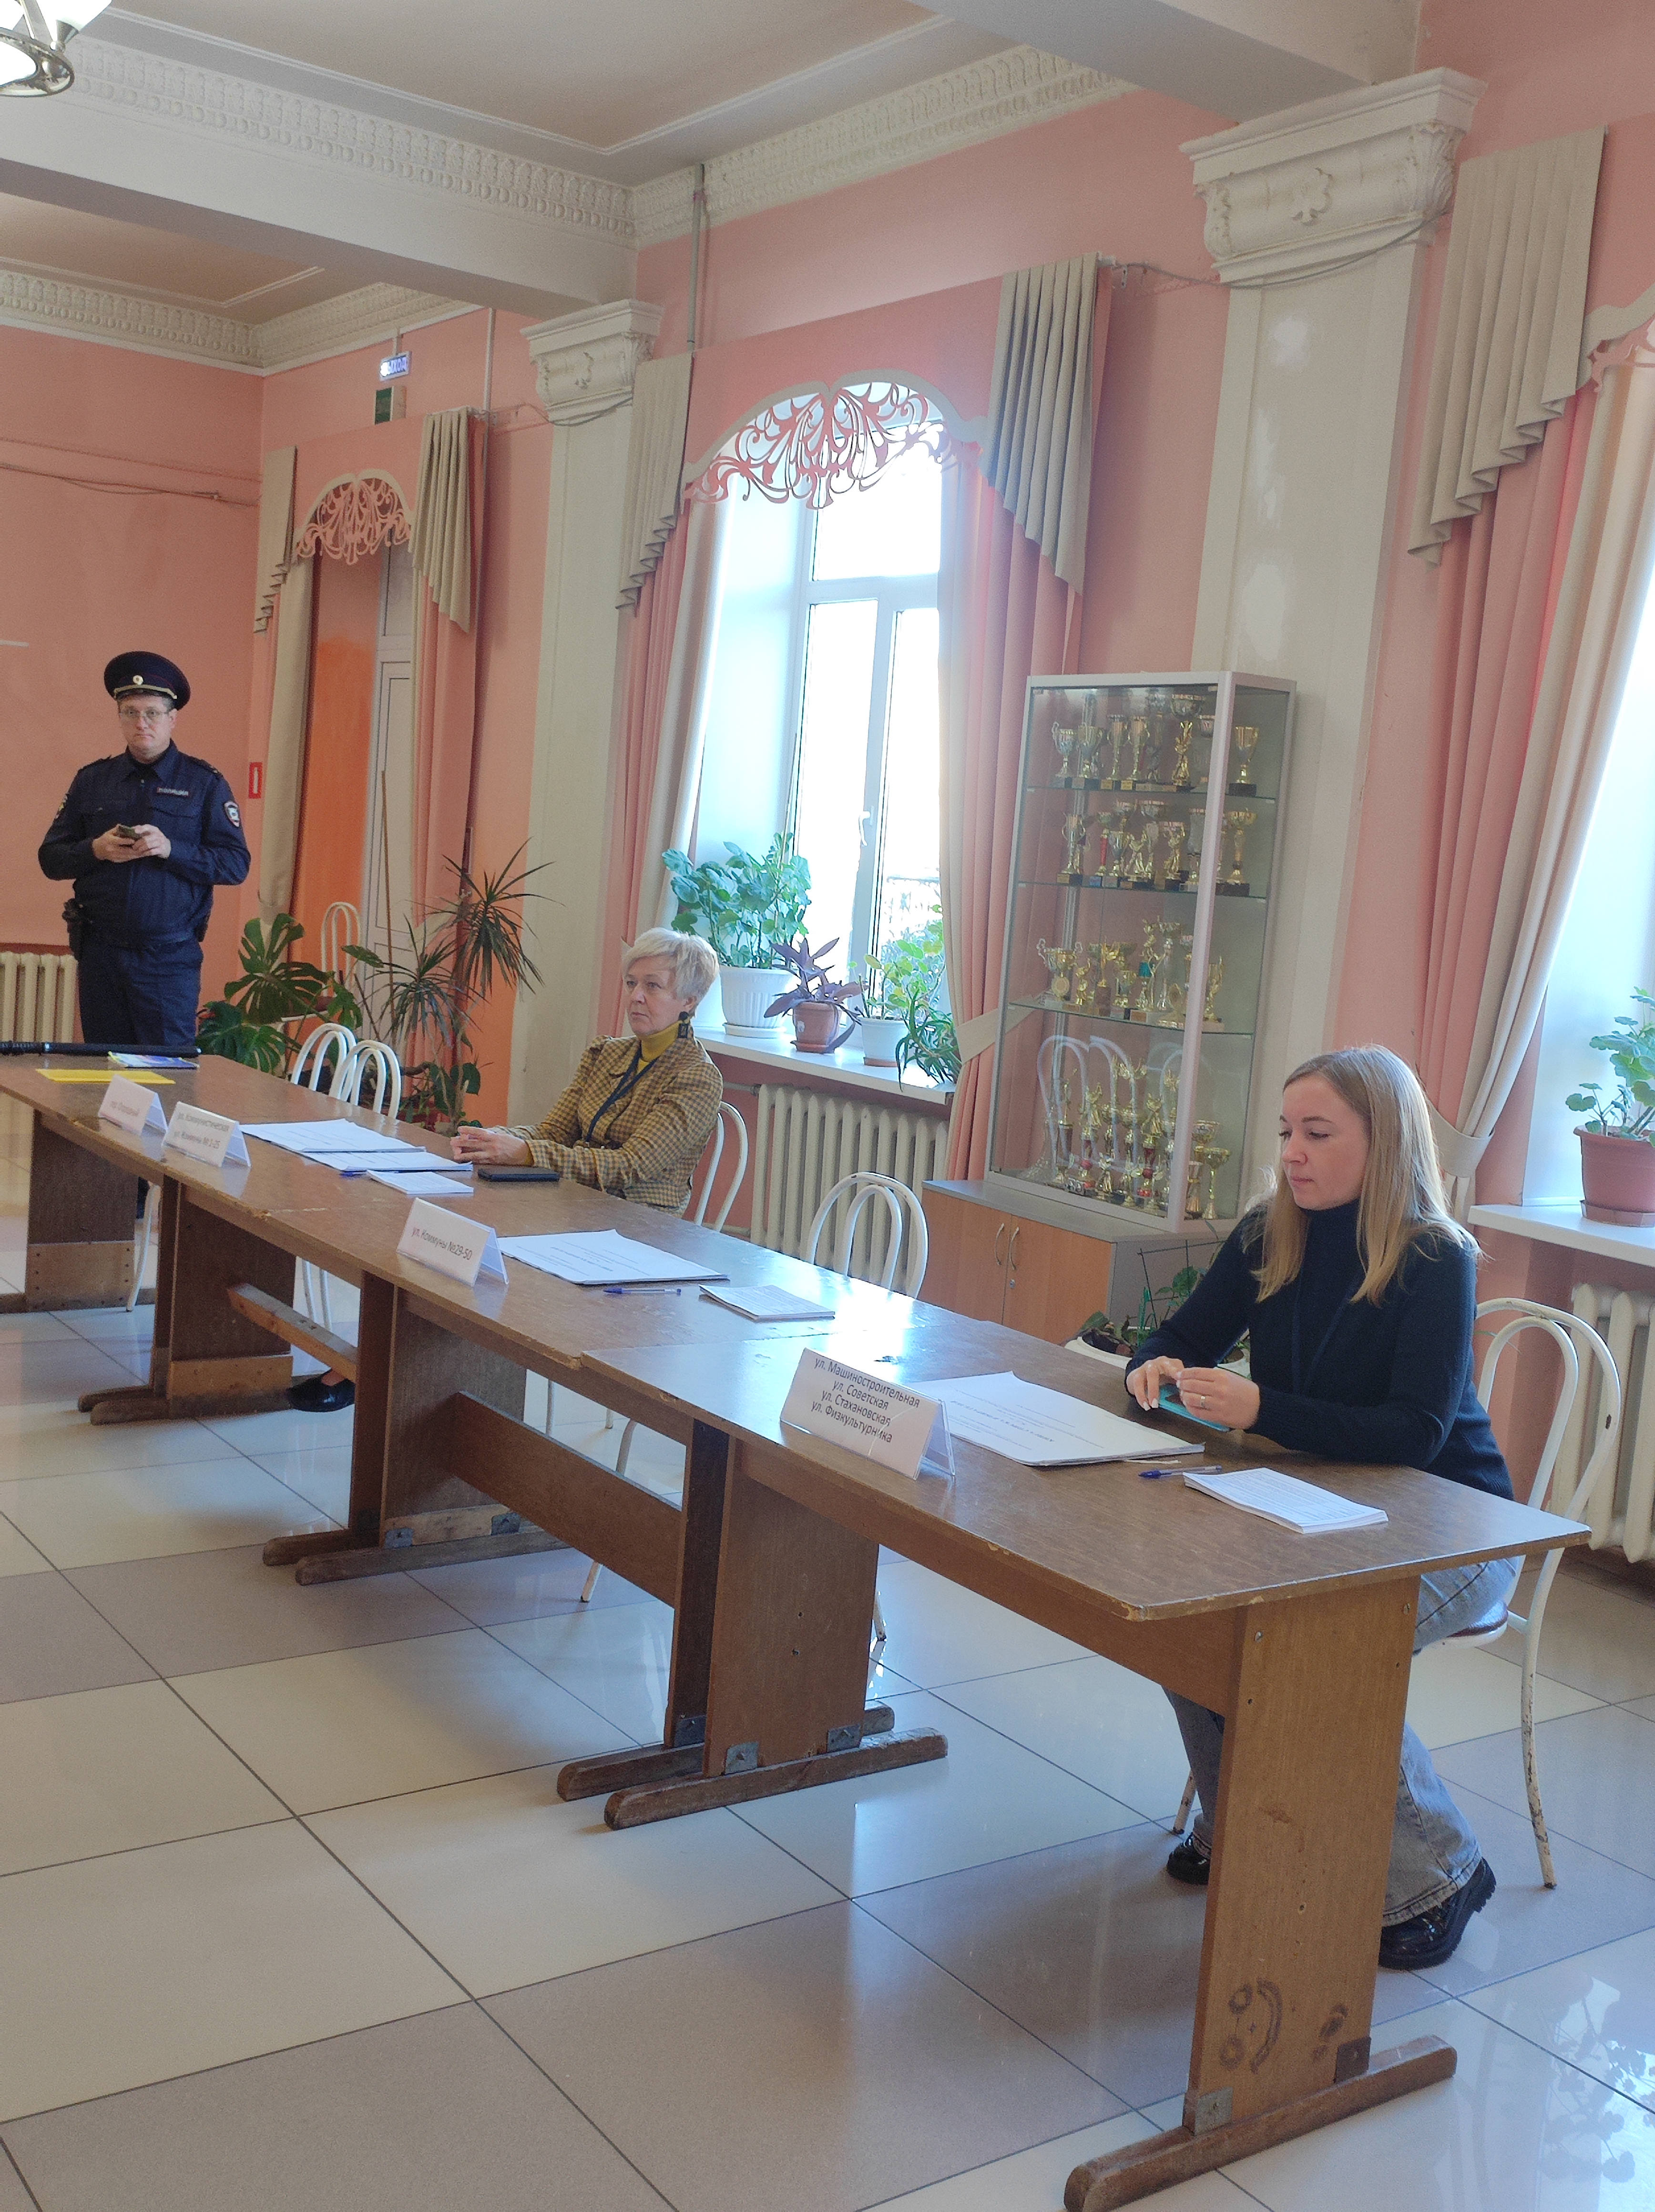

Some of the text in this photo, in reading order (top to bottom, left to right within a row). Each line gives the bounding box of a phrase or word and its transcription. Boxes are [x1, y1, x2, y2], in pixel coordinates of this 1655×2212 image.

[380, 357, 409, 377] ЫХОД
[814, 1358, 920, 1408] ул. Машиностроительная
[832, 1380, 889, 1411] ул. Советская
[811, 1401, 892, 1443] ул. Физкультурника
[821, 1390, 891, 1427] ул. Стахановская
